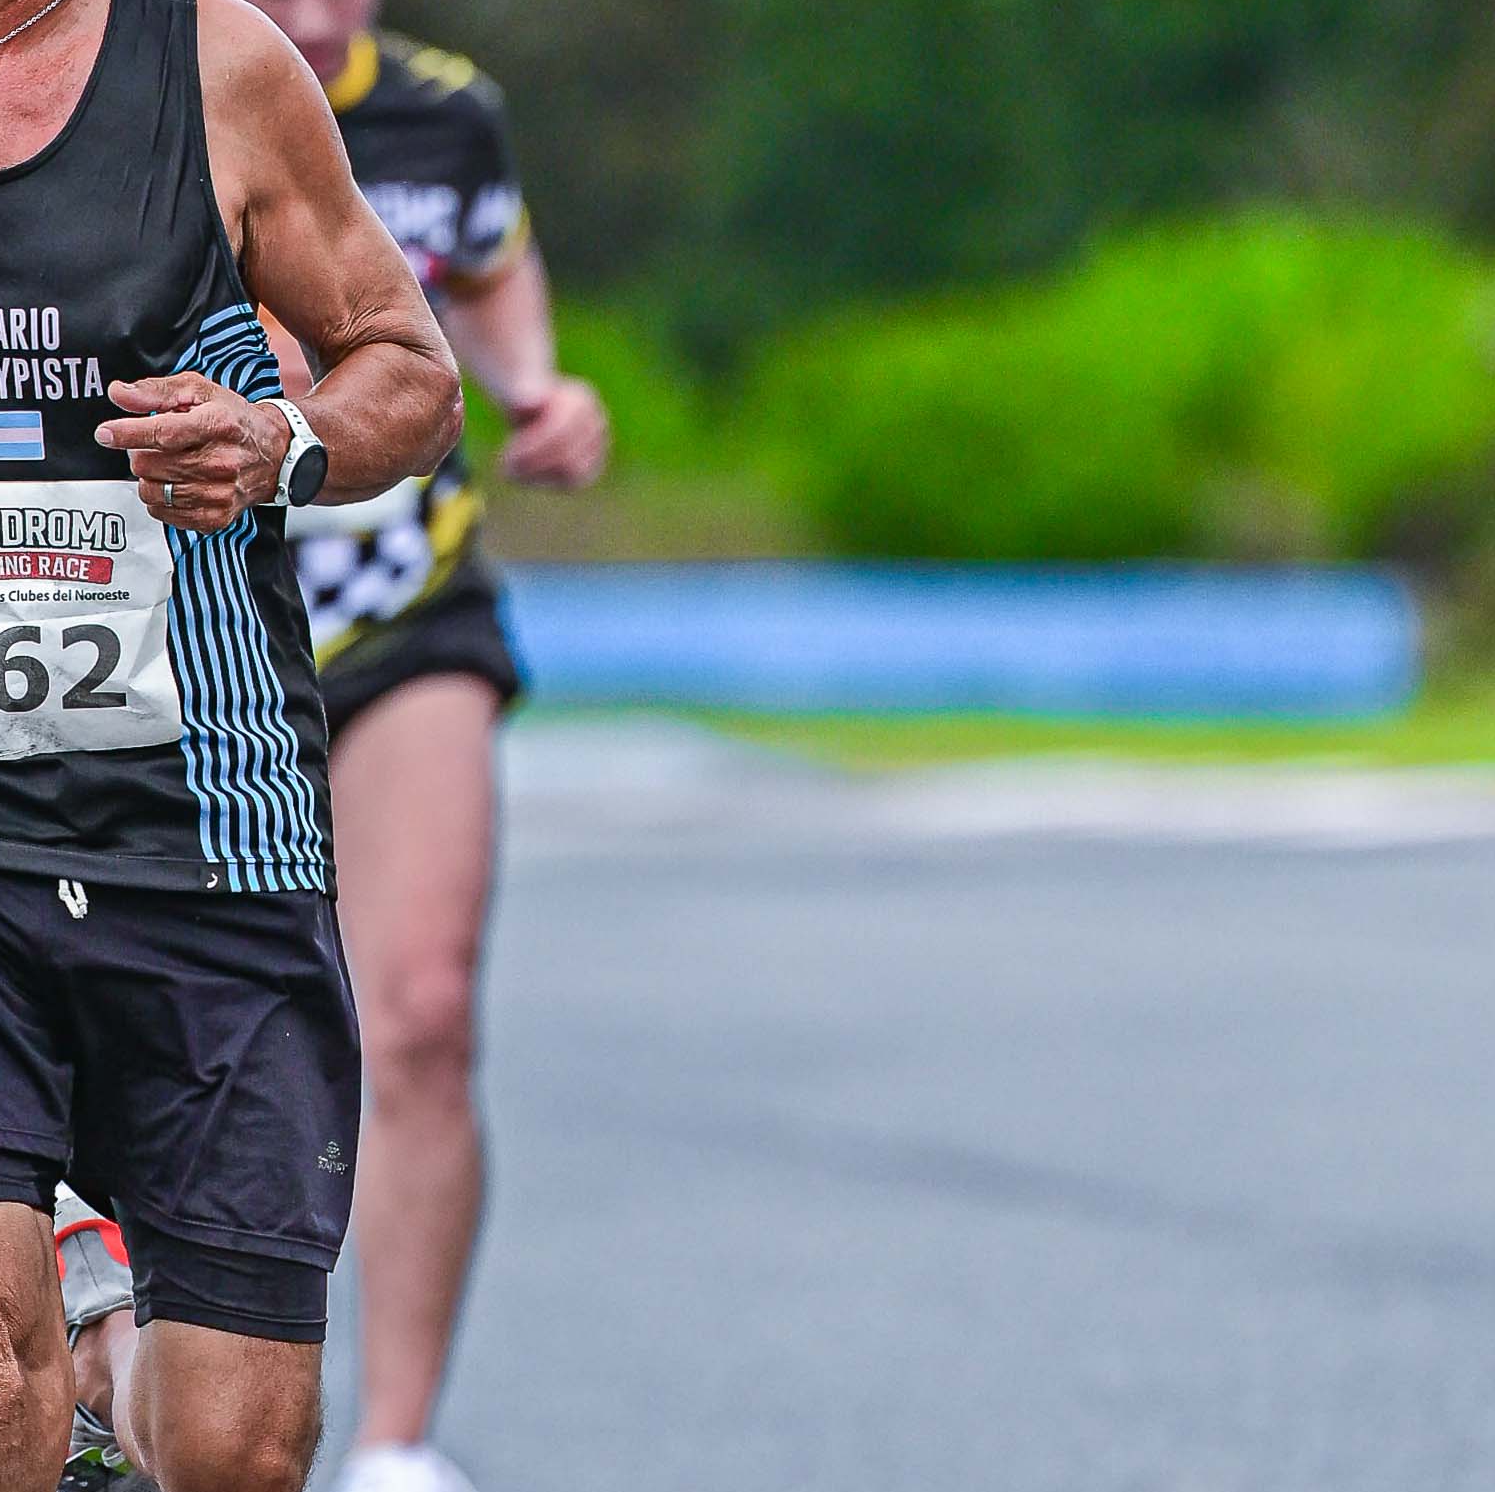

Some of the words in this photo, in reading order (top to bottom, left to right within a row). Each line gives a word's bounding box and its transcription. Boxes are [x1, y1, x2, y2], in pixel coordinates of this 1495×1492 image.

[38, 556, 92, 580] RACE
[8, 590, 50, 602] Clubes
[54, 590, 72, 602] del
[75, 589, 130, 602] Noroeste
